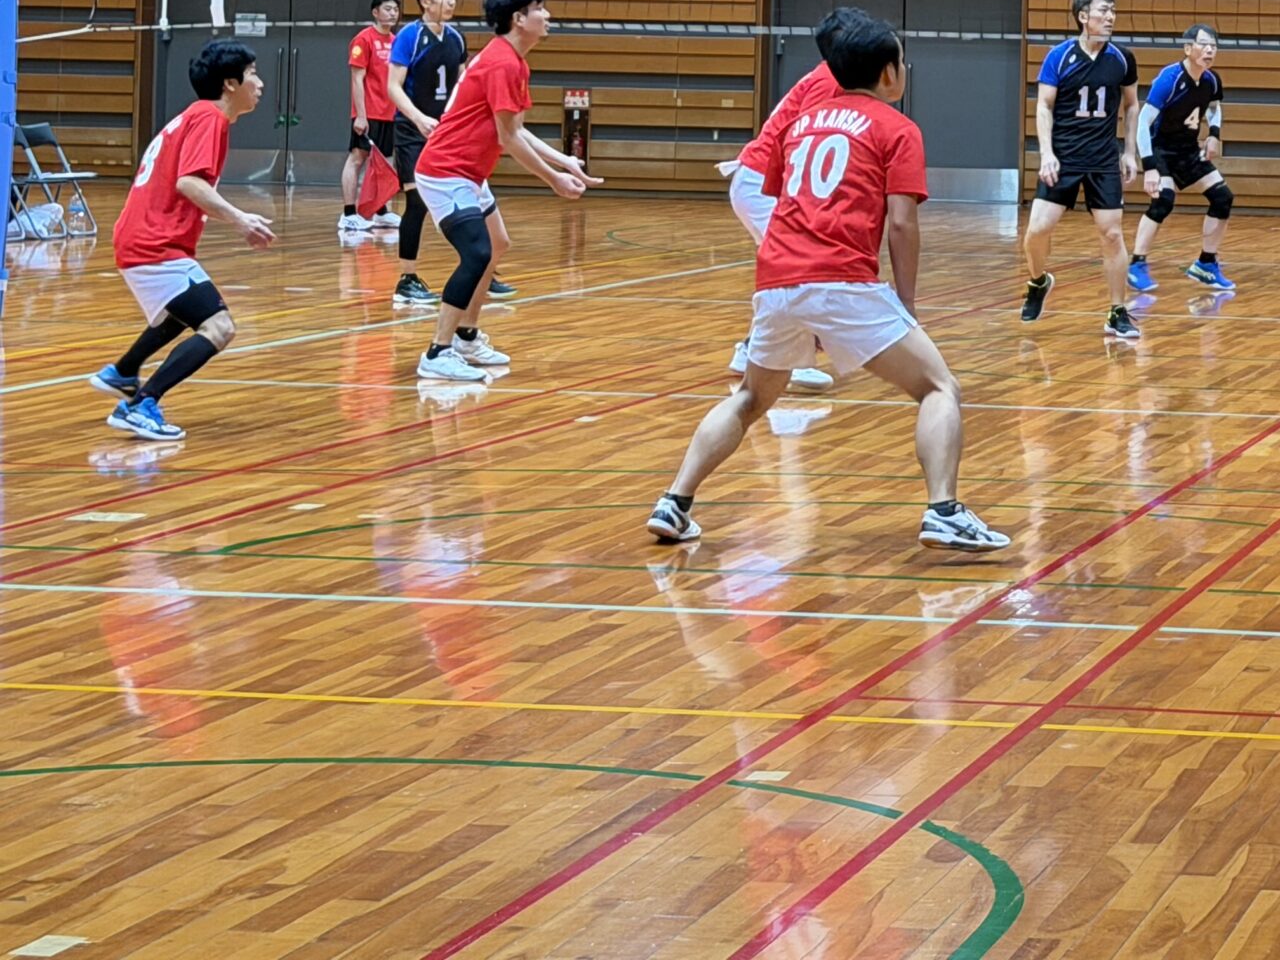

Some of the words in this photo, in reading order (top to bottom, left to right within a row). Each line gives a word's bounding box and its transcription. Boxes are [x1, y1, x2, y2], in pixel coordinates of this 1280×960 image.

[435, 65, 447, 94] 1
[1075, 85, 1107, 117] 11
[792, 114, 811, 137] JP
[813, 109, 872, 136] KANSAI
[1183, 106, 1200, 129] 4
[787, 133, 850, 199] 10
